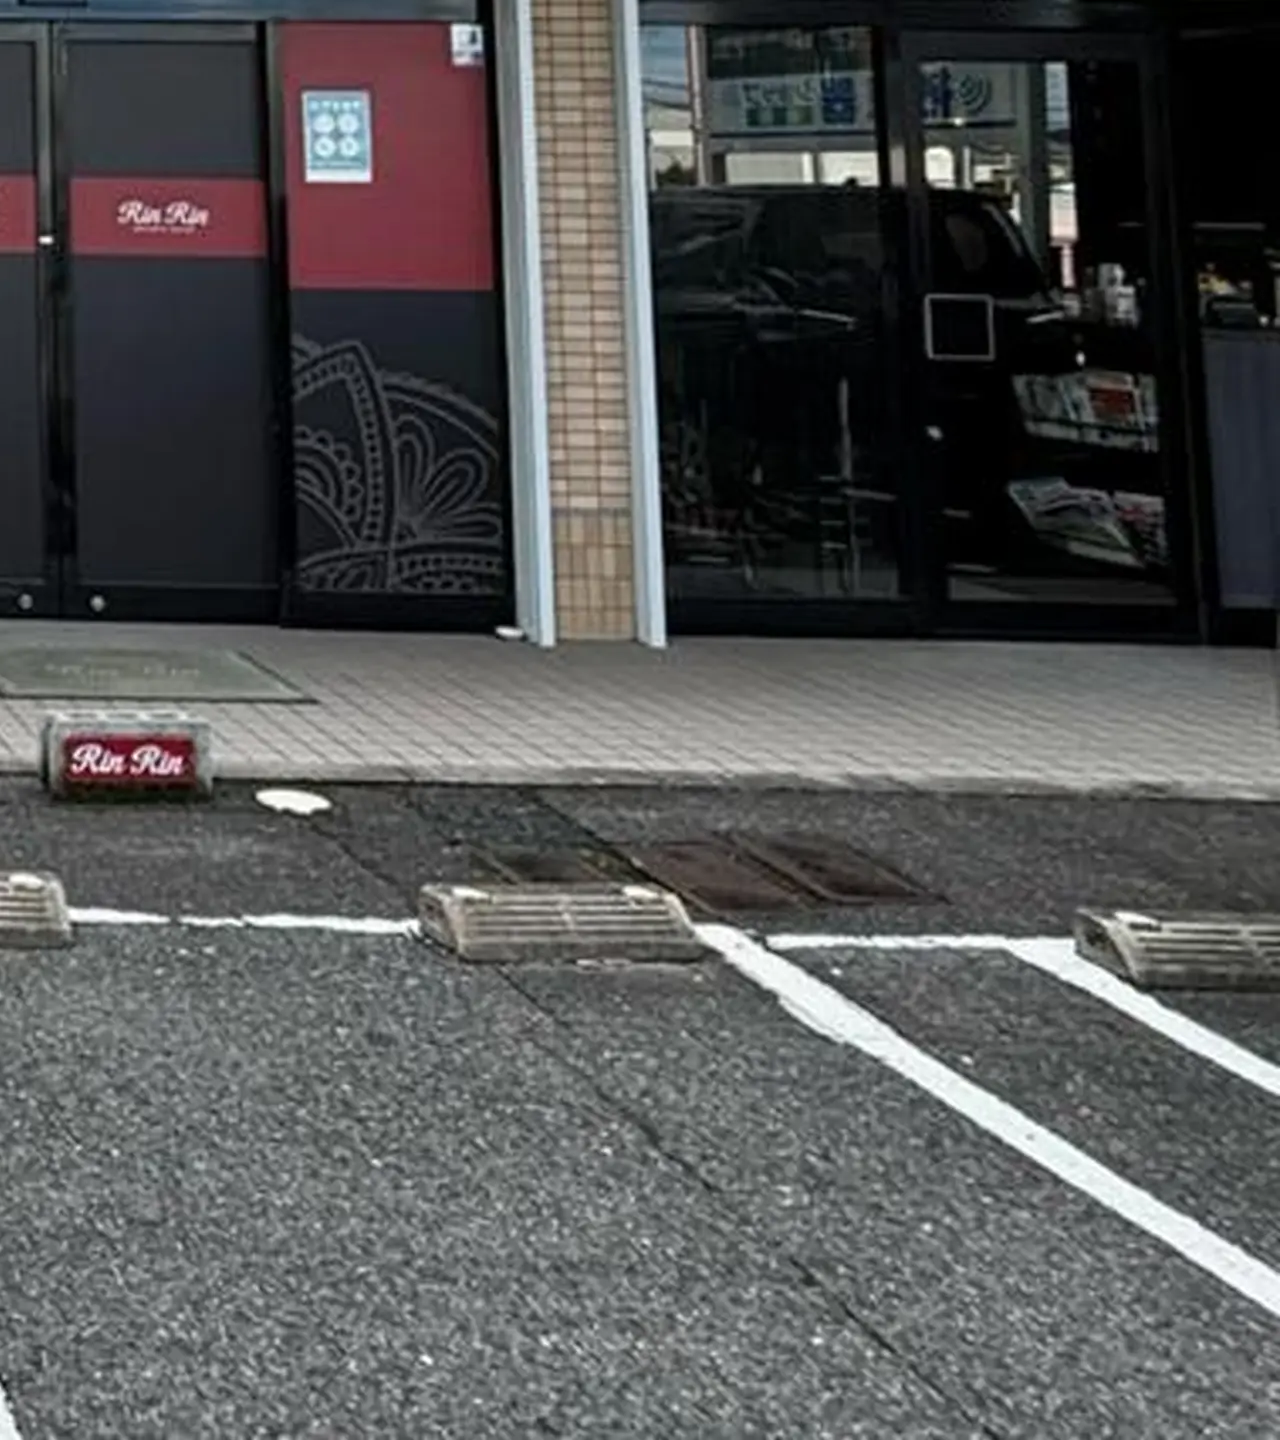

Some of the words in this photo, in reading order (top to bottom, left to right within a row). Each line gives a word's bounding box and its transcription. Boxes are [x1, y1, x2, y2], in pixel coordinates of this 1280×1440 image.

[117, 200, 161, 225] Rin
[164, 201, 209, 227] Rin
[70, 742, 126, 775] Rin
[129, 744, 184, 776] Rin
